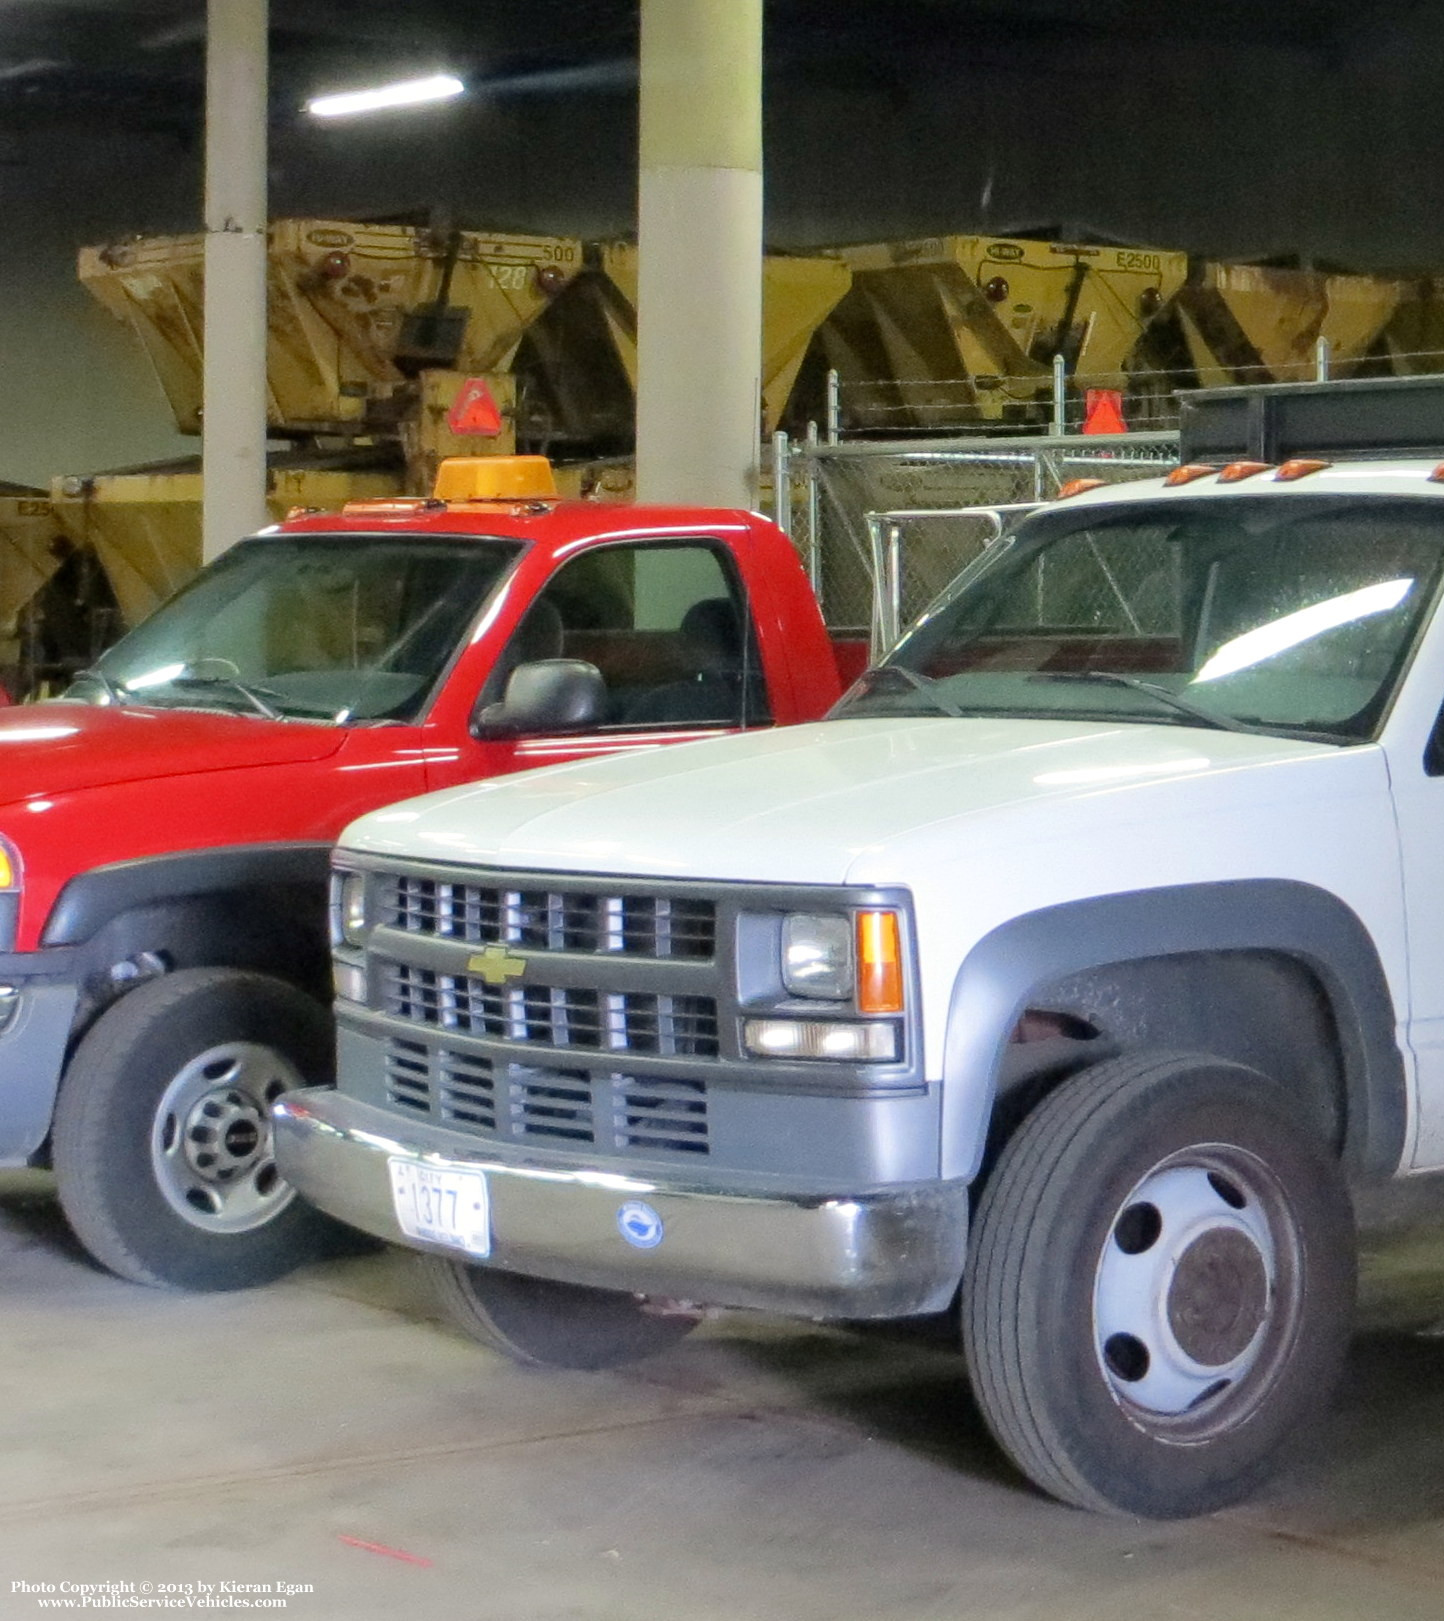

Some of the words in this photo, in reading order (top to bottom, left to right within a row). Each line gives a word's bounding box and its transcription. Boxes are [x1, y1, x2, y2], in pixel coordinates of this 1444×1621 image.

[543, 245, 575, 262] 500
[1117, 252, 1161, 271] E2500
[17, 501, 55, 516] E25
[411, 1183, 458, 1229] 1377
